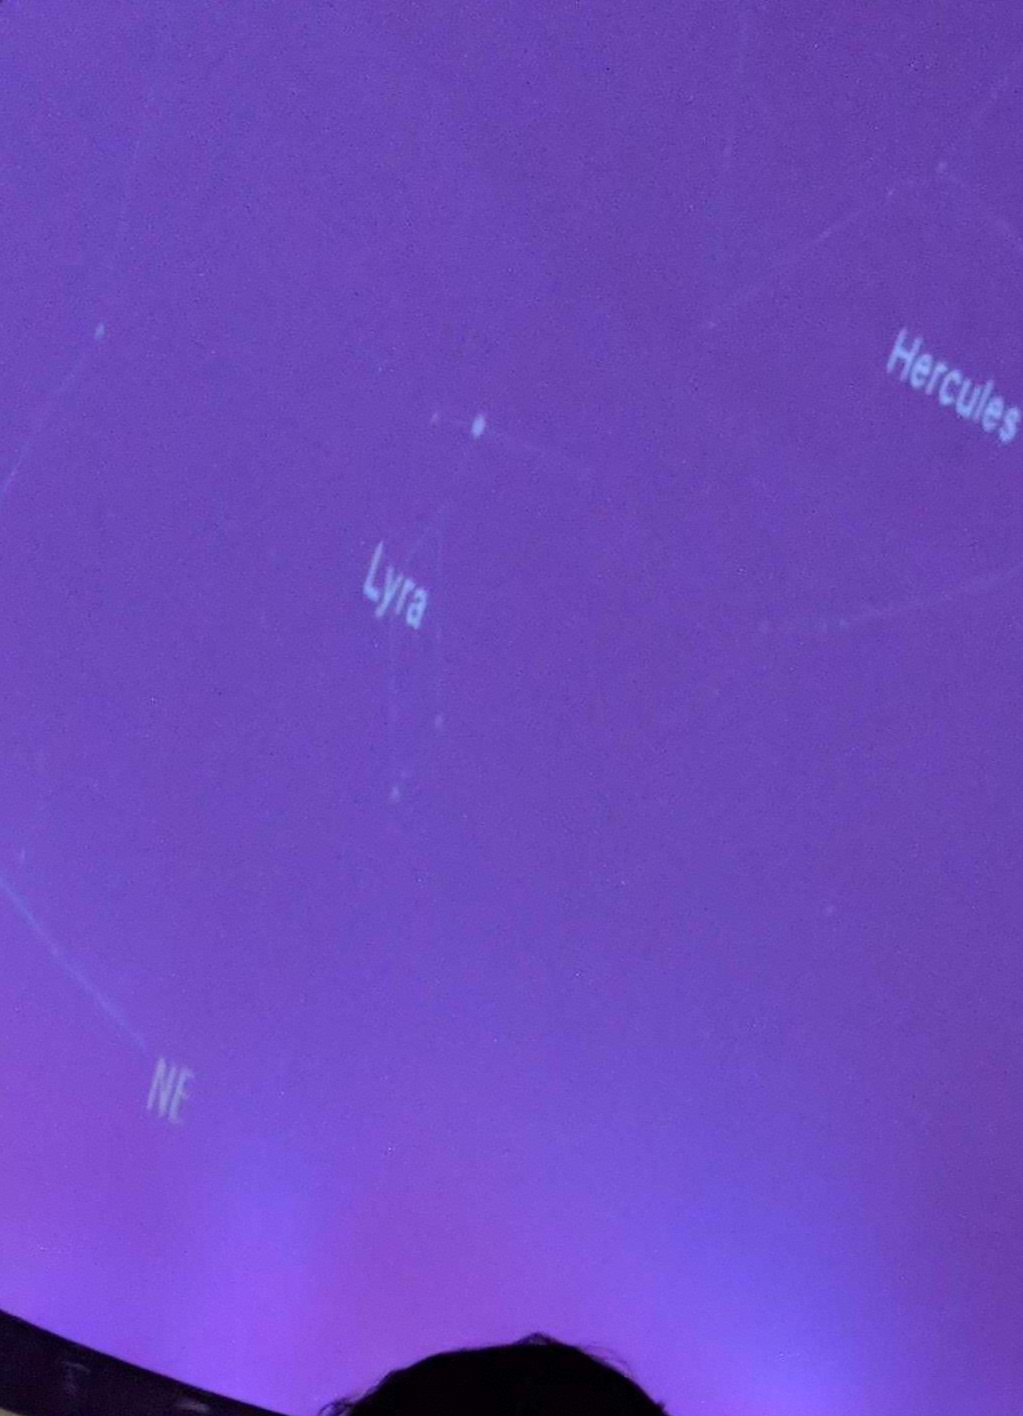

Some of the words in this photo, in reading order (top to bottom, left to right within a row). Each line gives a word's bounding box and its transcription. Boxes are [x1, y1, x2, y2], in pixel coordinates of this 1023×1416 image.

[886, 328, 1021, 442] Hercules
[363, 540, 428, 630] Lyra
[146, 1057, 194, 1122] NE
